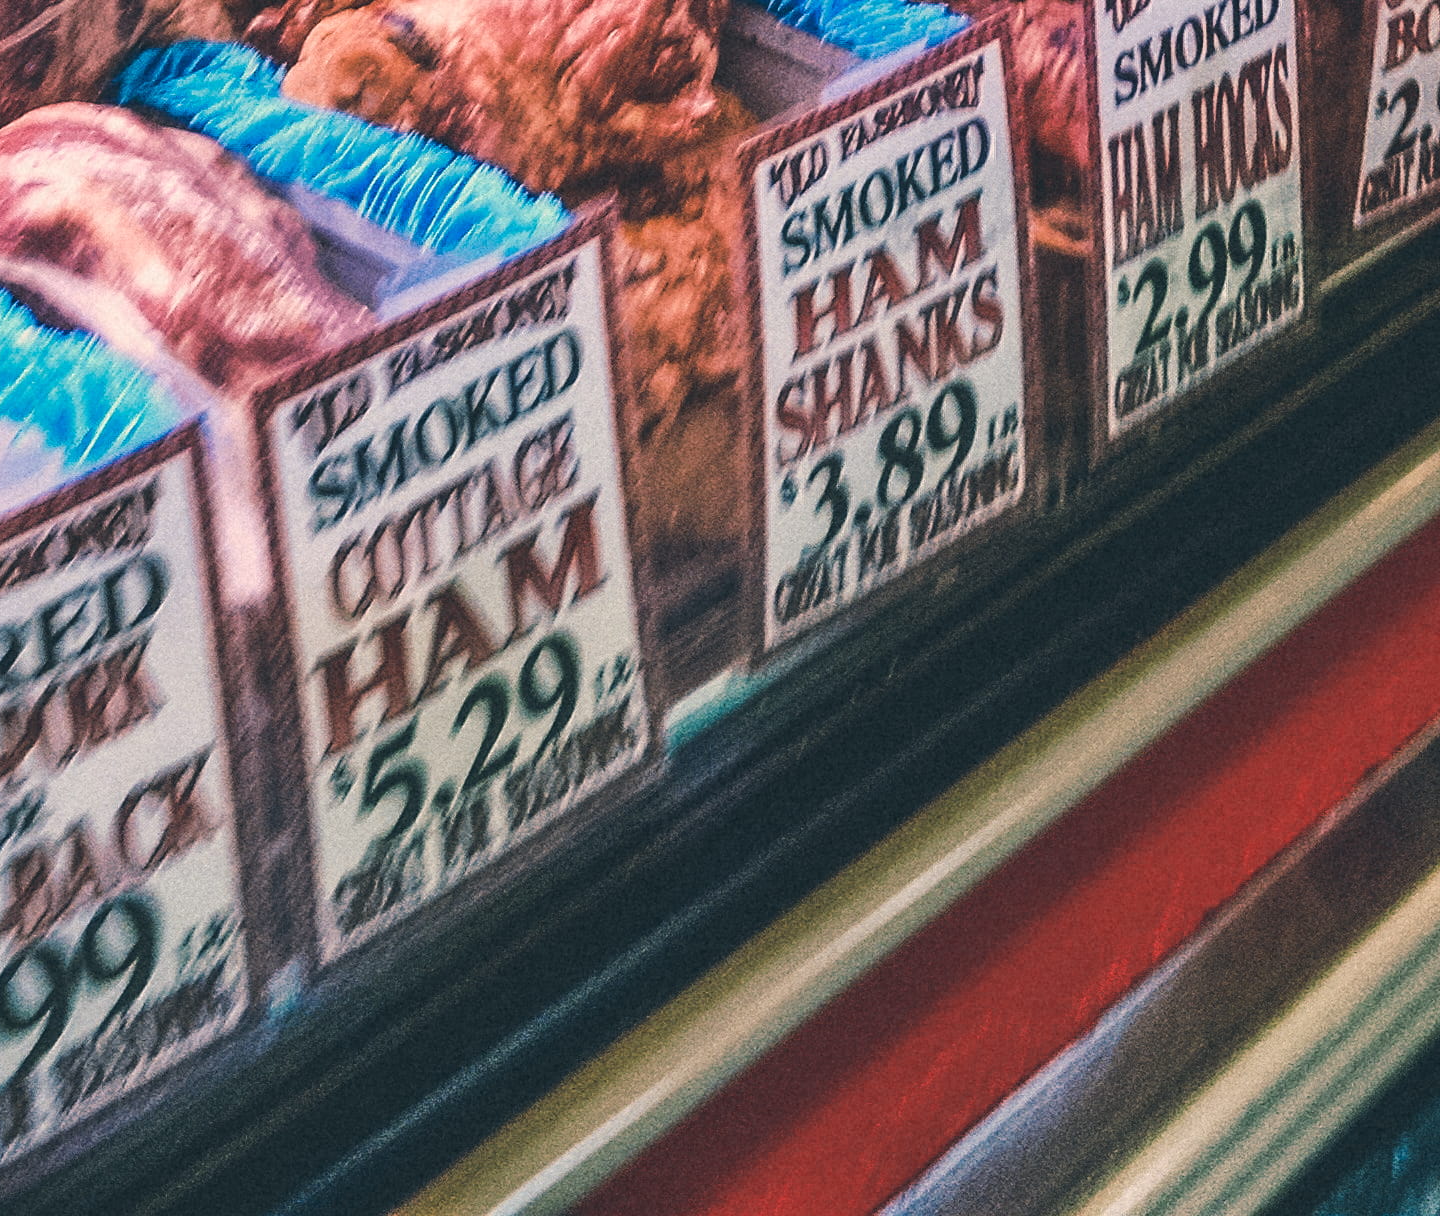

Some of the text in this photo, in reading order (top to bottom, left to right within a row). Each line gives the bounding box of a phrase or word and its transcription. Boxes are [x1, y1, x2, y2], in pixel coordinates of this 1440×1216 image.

[781, 115, 992, 276] SMOKED
[1108, 44, 1294, 268] HAM HOCKS
[776, 266, 1005, 468] SHANKS
[791, 189, 985, 361] HAM
[1117, 199, 1268, 356] $2.99
[306, 331, 582, 533] SMOKED
[325, 408, 582, 623] COTTAGE
[781, 378, 978, 553] $3.89
[312, 488, 607, 757] HAM
[332, 636, 582, 844] $5.29
